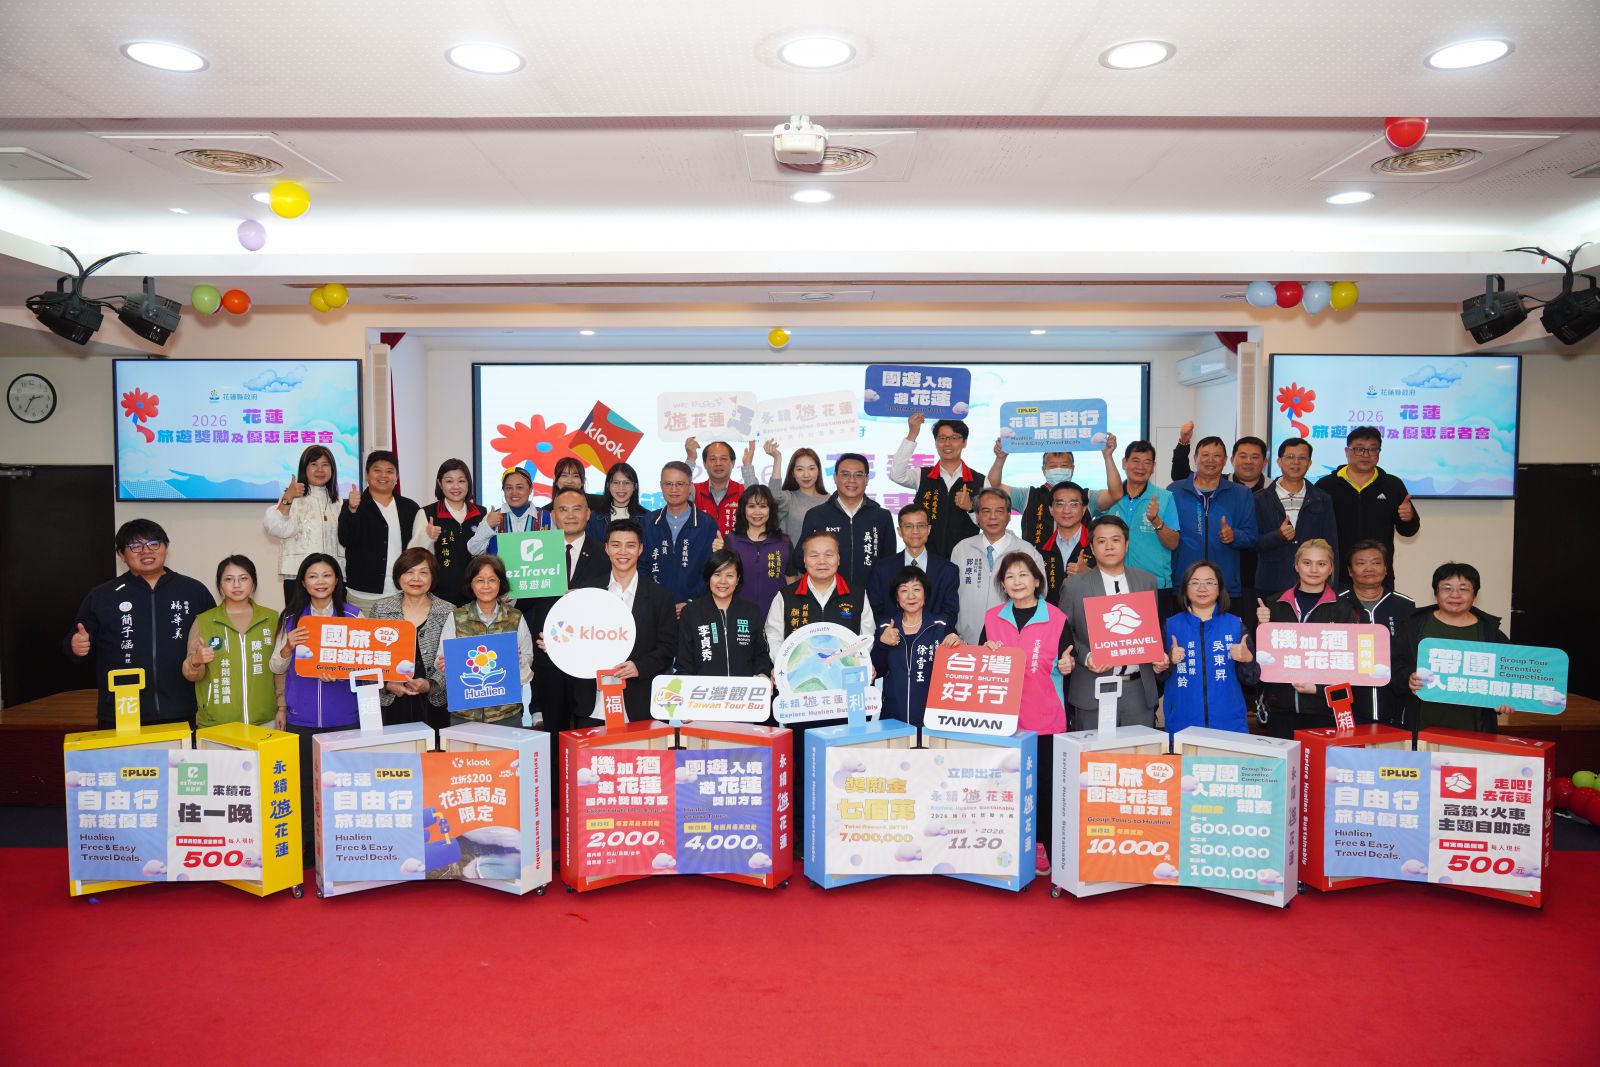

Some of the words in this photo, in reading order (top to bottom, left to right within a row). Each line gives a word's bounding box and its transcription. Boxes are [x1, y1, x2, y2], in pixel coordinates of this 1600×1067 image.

[192, 414, 227, 427] 2026
[242, 408, 284, 424] 花蓮
[663, 410, 726, 432] 遊花蓮
[1348, 410, 1384, 422] 2026
[1400, 404, 1440, 420] 花蓮
[158, 430, 334, 444] 旅遊獎勵及優惠記者會
[584, 422, 626, 460] klook
[864, 531, 873, 566] 吳建志
[506, 564, 560, 578] ezTravel
[518, 578, 552, 590] 易遊網
[320, 624, 372, 650] 國旅
[580, 626, 628, 641] klook
[1271, 629, 1348, 650] 機加酒
[698, 624, 712, 662] 李貞秀
[1095, 639, 1118, 650] LION
[1120, 636, 1158, 646] TRAVEL
[916, 644, 928, 682] 徐雪玉
[946, 652, 1012, 674] 台灣
[1212, 640, 1227, 682] 吳東昇
[1284, 651, 1354, 670] 遊花蓮
[1428, 648, 1496, 678] 帶團
[1500, 656, 1526, 665] Group
[1529, 658, 1548, 666] Tour
[1500, 664, 1542, 674] Incentive
[978, 676, 1010, 684] SHUTTLE
[1500, 672, 1554, 682] Competition
[464, 686, 506, 700] Hualien
[690, 685, 768, 702] 台灣觀巴
[940, 682, 1009, 705] 好行
[118, 696, 138, 714] 花
[606, 695, 623, 714] 福
[723, 702, 746, 710] Tour
[747, 702, 765, 710] Bus
[850, 692, 864, 712] 利
[938, 715, 1004, 730] TAIWAN
[1338, 710, 1354, 729] 箱
[466, 758, 491, 767] klook
[591, 756, 661, 776] 機加酒
[78, 772, 117, 787] 花蓮
[128, 769, 157, 777] PLUS
[334, 772, 372, 787] 花蓮
[383, 770, 411, 778] PLUS
[450, 773, 492, 786] 立折$200
[1088, 762, 1144, 787] 國旅
[1192, 764, 1239, 782] 帶團
[1336, 768, 1374, 784] 花蓮
[1386, 769, 1418, 778] PLUS
[598, 776, 662, 794] 遊花蓮
[700, 776, 762, 795] 遊花蓮
[1494, 778, 1532, 792] 走吧!
[78, 789, 158, 810] 自由行
[334, 790, 413, 811] 自由行
[438, 786, 507, 810] 花蓮商品
[777, 754, 790, 850] 永續遊花蓮
[1334, 786, 1420, 810] 自由行
[1482, 790, 1532, 804] 去花蓮
[178, 803, 253, 824] 住一晚
[270, 760, 293, 858] 永續遊花蓮
[458, 806, 494, 824] 限定
[79, 813, 158, 828] 旅遊優惠
[334, 813, 413, 828] 旅遊優惠
[1334, 810, 1419, 829] 旅遊優惠
[1438, 818, 1530, 836] 主題自助遊
[840, 832, 914, 843] 7,000,000
[1190, 823, 1270, 837] 600,000
[1335, 829, 1373, 838] Hualien
[586, 831, 660, 848] 2,000
[684, 834, 758, 852] 4,000
[948, 837, 1002, 850] 11.30
[1086, 838, 1170, 856] 10,000
[1334, 840, 1358, 848] Free
[1368, 841, 1396, 851] Easy
[112, 844, 136, 853] Easy
[368, 844, 394, 853] Easy
[1189, 844, 1270, 859] 300,000
[1334, 849, 1366, 858] Travel
[183, 850, 244, 868] 500
[336, 854, 368, 862] Travel
[1448, 854, 1516, 875] 500
[1190, 864, 1270, 880] 100,000
